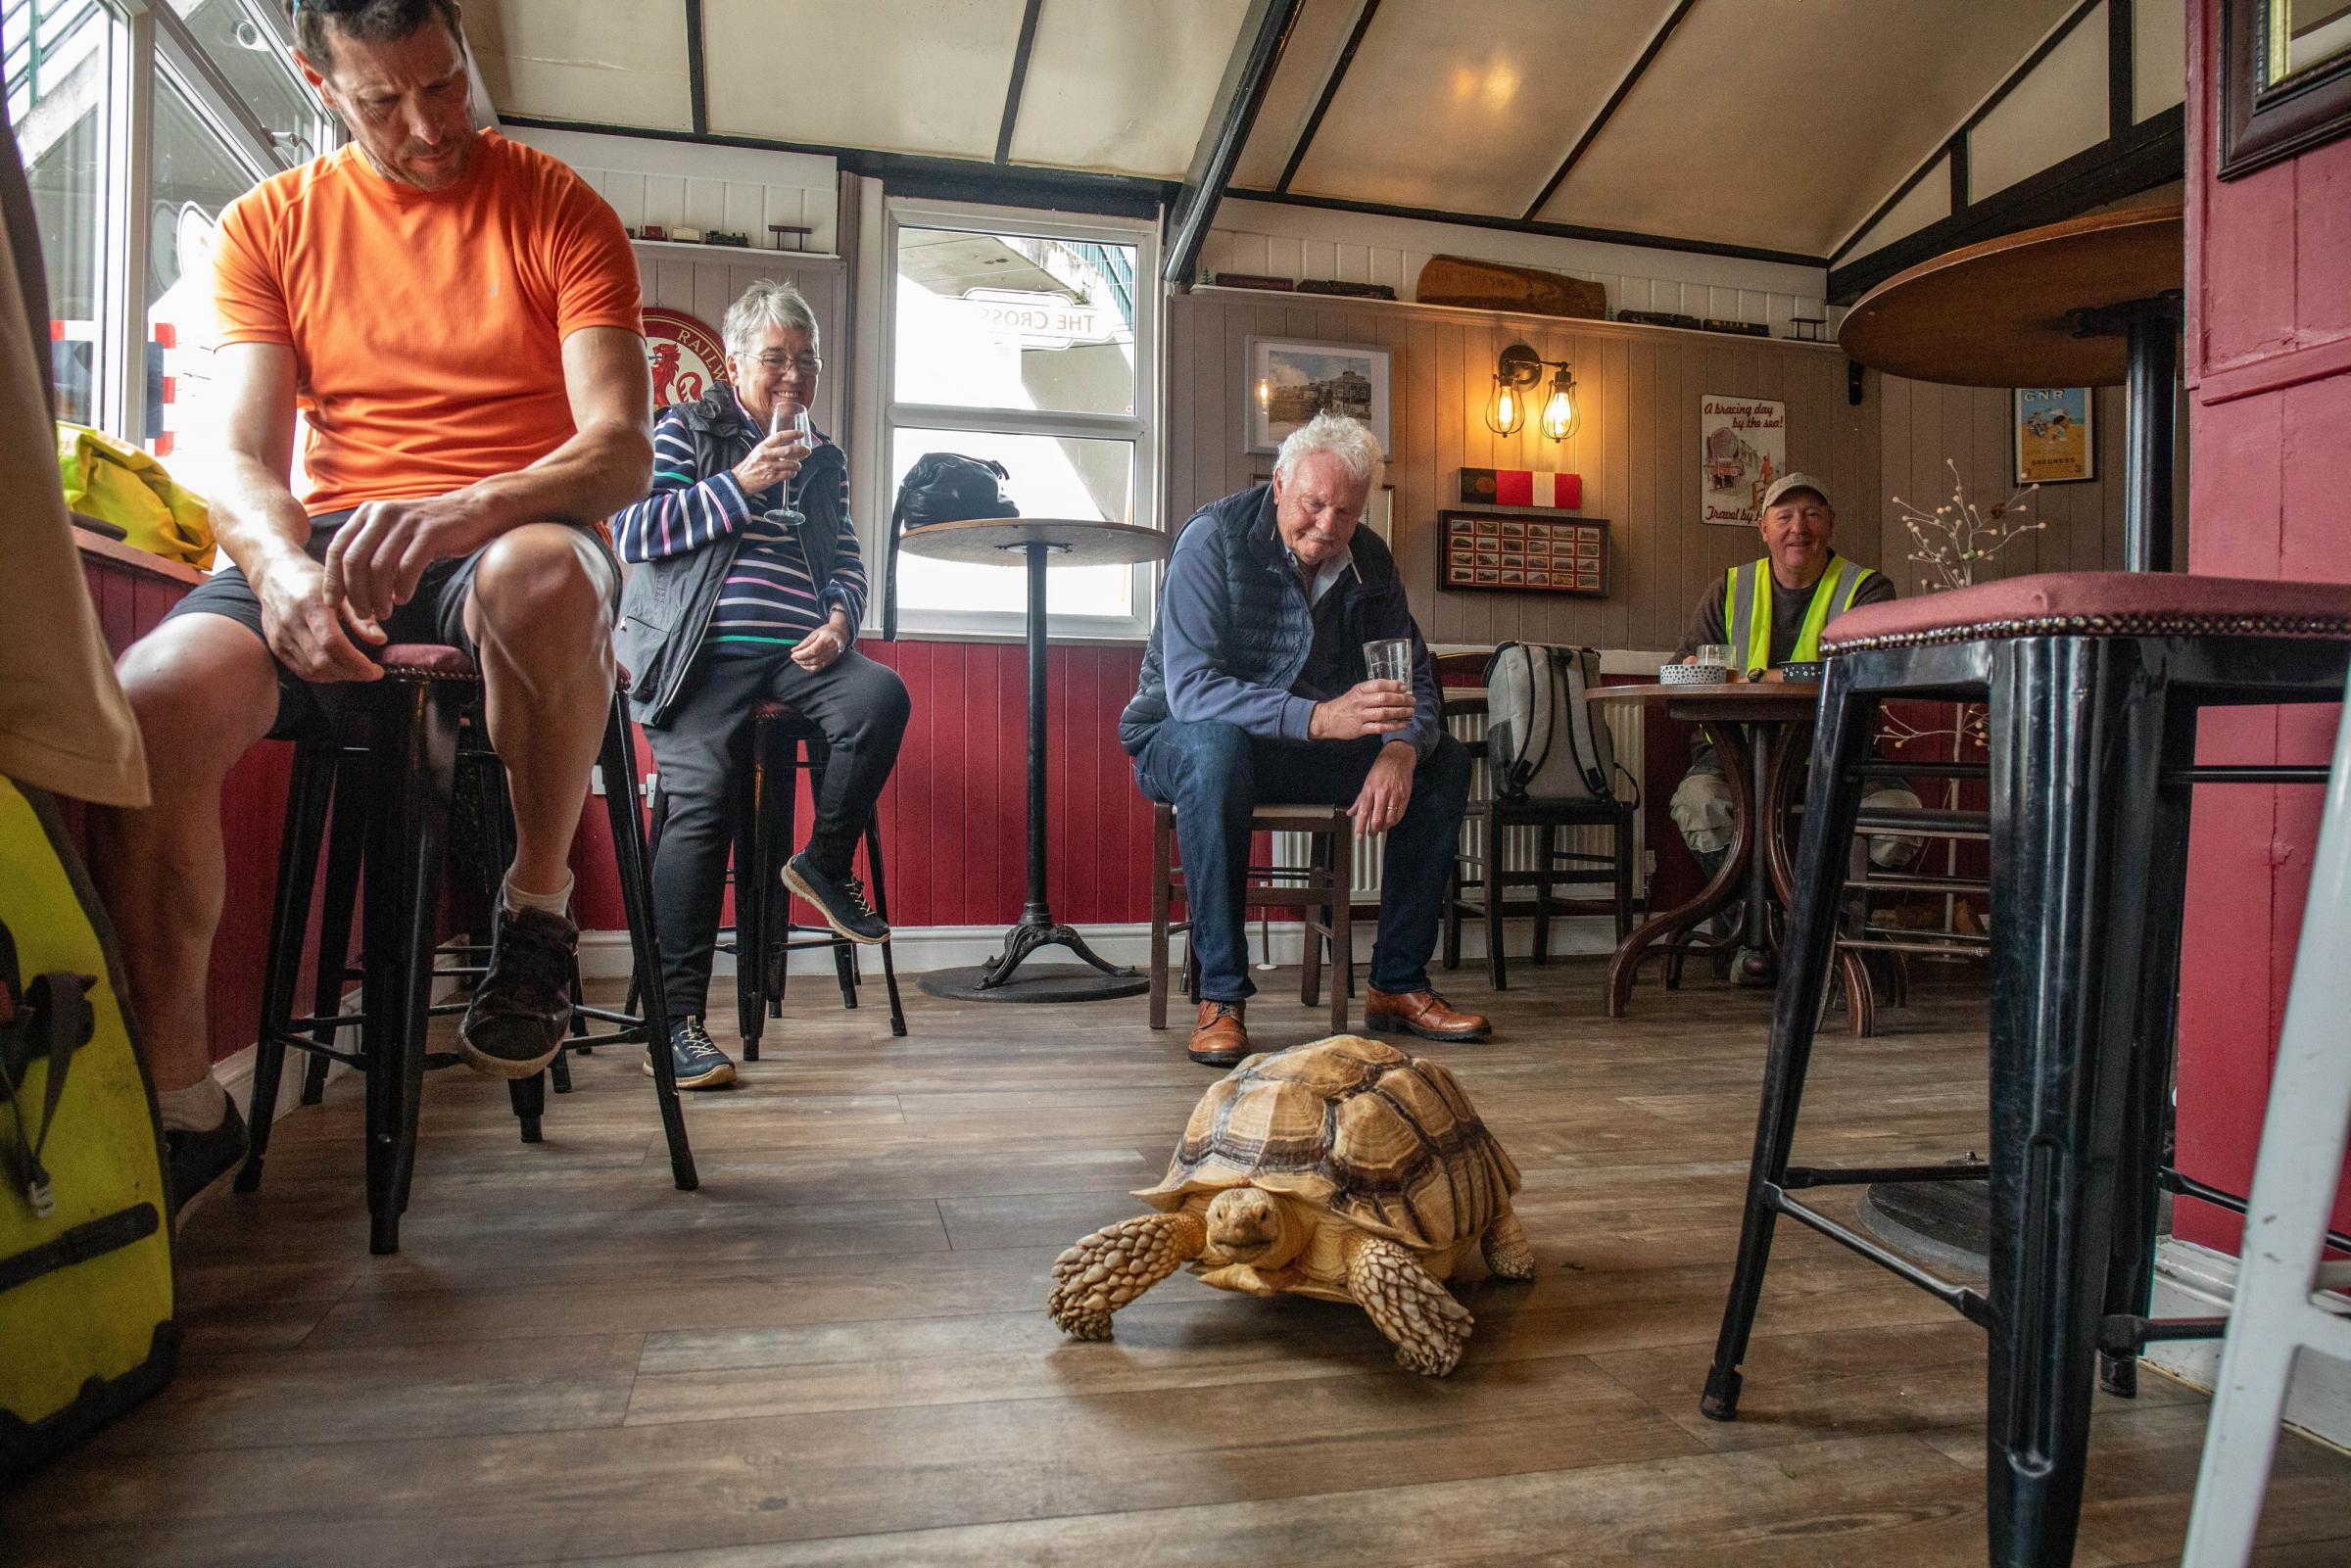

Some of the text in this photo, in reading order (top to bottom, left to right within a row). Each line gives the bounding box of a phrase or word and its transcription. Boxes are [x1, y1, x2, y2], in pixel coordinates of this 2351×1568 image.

[677, 329, 728, 381] RAILW
[1703, 403, 1773, 417] A bracing day
[1732, 415, 1783, 431] by the sea!
[1705, 505, 1740, 520] Travel
[1740, 508, 1753, 525] by
